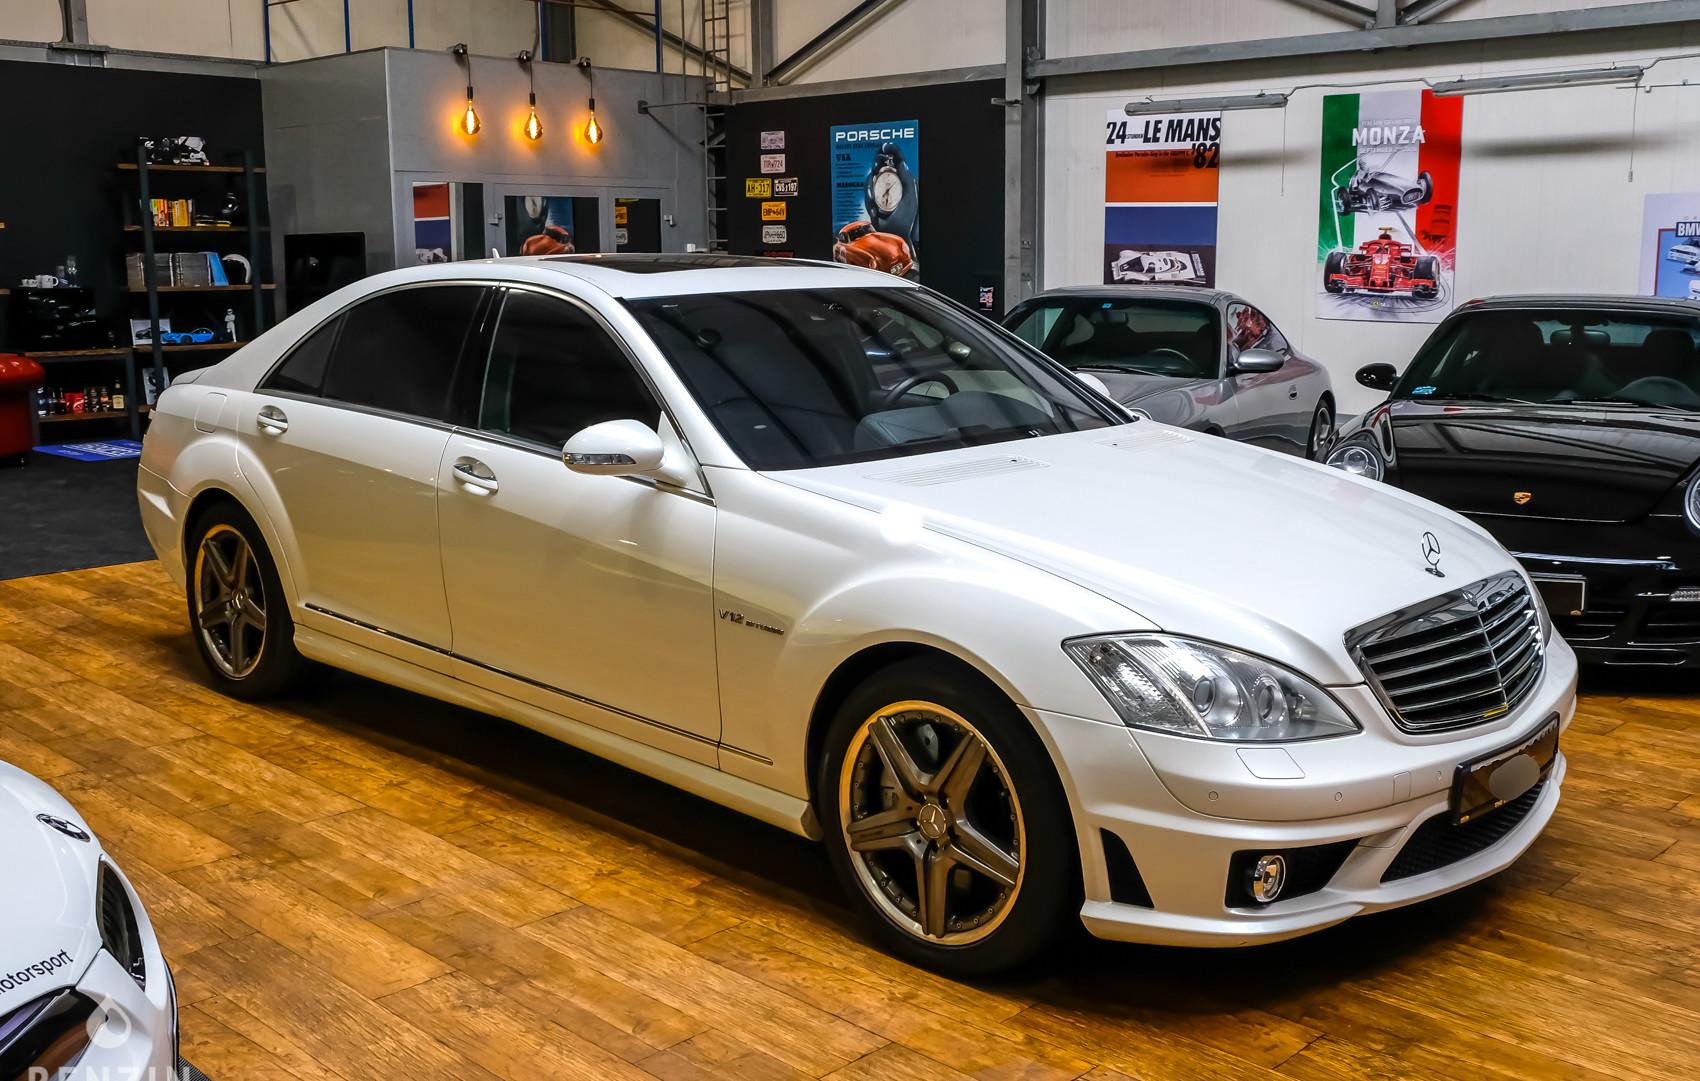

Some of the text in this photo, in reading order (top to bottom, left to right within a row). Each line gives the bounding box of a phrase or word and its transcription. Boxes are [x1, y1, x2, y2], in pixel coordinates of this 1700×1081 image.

[835, 128, 915, 142] PORSCHE
[1106, 121, 1128, 144] 24
[1143, 119, 1163, 144] LE
[1165, 117, 1221, 143] MANS
[1352, 125, 1425, 146] MONZA
[1191, 142, 1220, 169] '82
[719, 609, 744, 624] V12
[0, 949, 73, 995] otorsport
